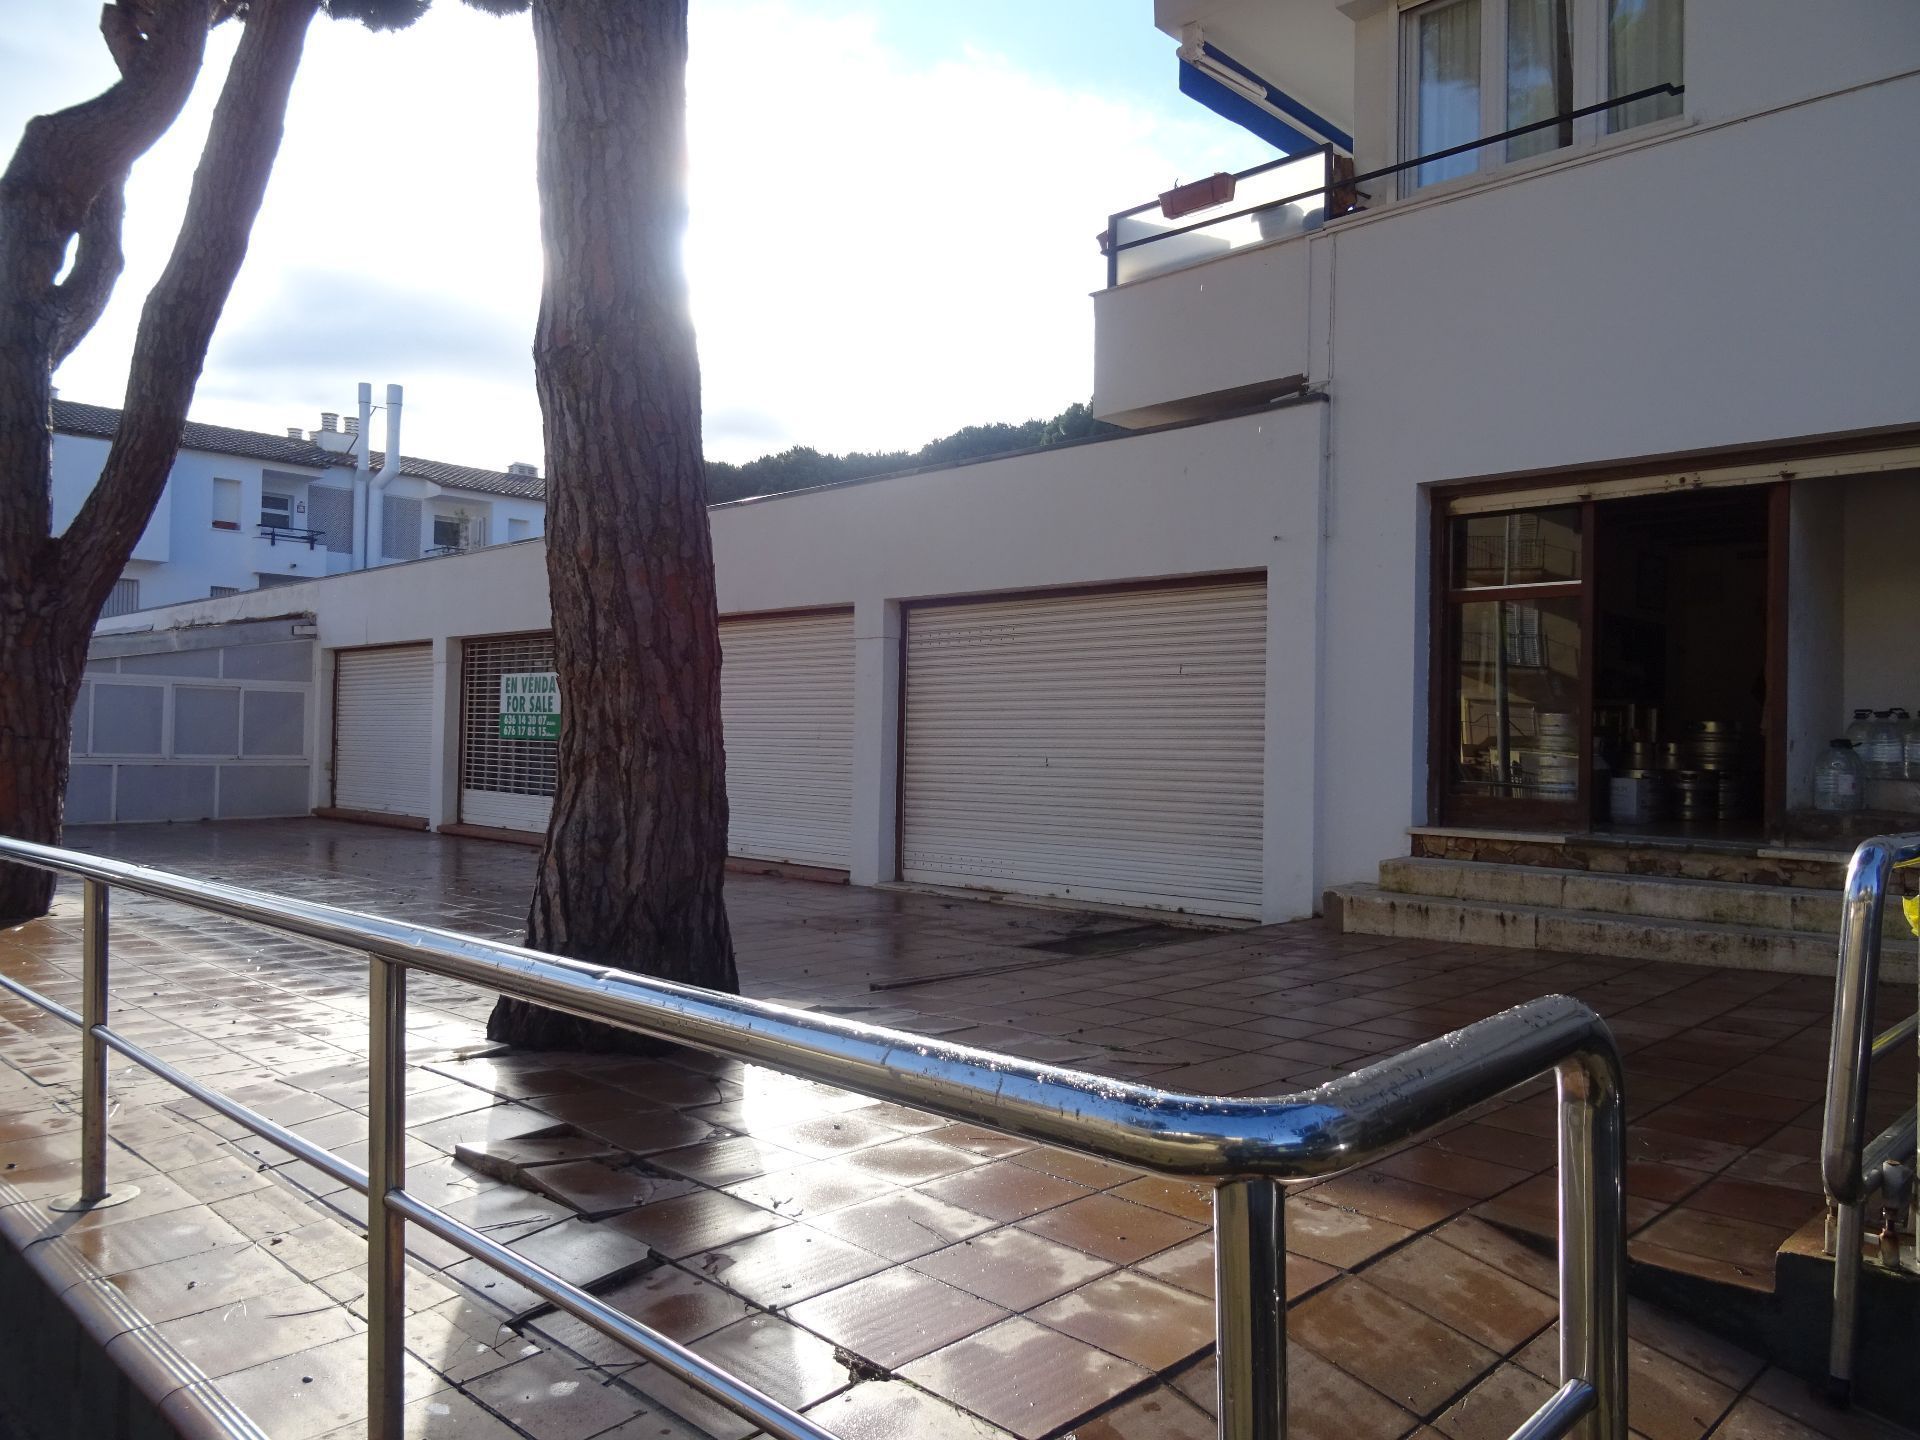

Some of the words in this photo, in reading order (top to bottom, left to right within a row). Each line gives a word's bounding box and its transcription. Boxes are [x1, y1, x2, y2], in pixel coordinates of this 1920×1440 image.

[505, 677, 518, 694] EN
[522, 675, 557, 694] VENDA
[506, 695, 526, 713] FOR
[530, 695, 554, 713] SALE
[504, 714, 517, 725] 636
[518, 714, 526, 725] 14
[527, 714, 537, 725] 30
[538, 714, 547, 725] 07
[503, 726, 516, 736] 676
[518, 726, 526, 736] 17
[538, 726, 547, 737] 15
